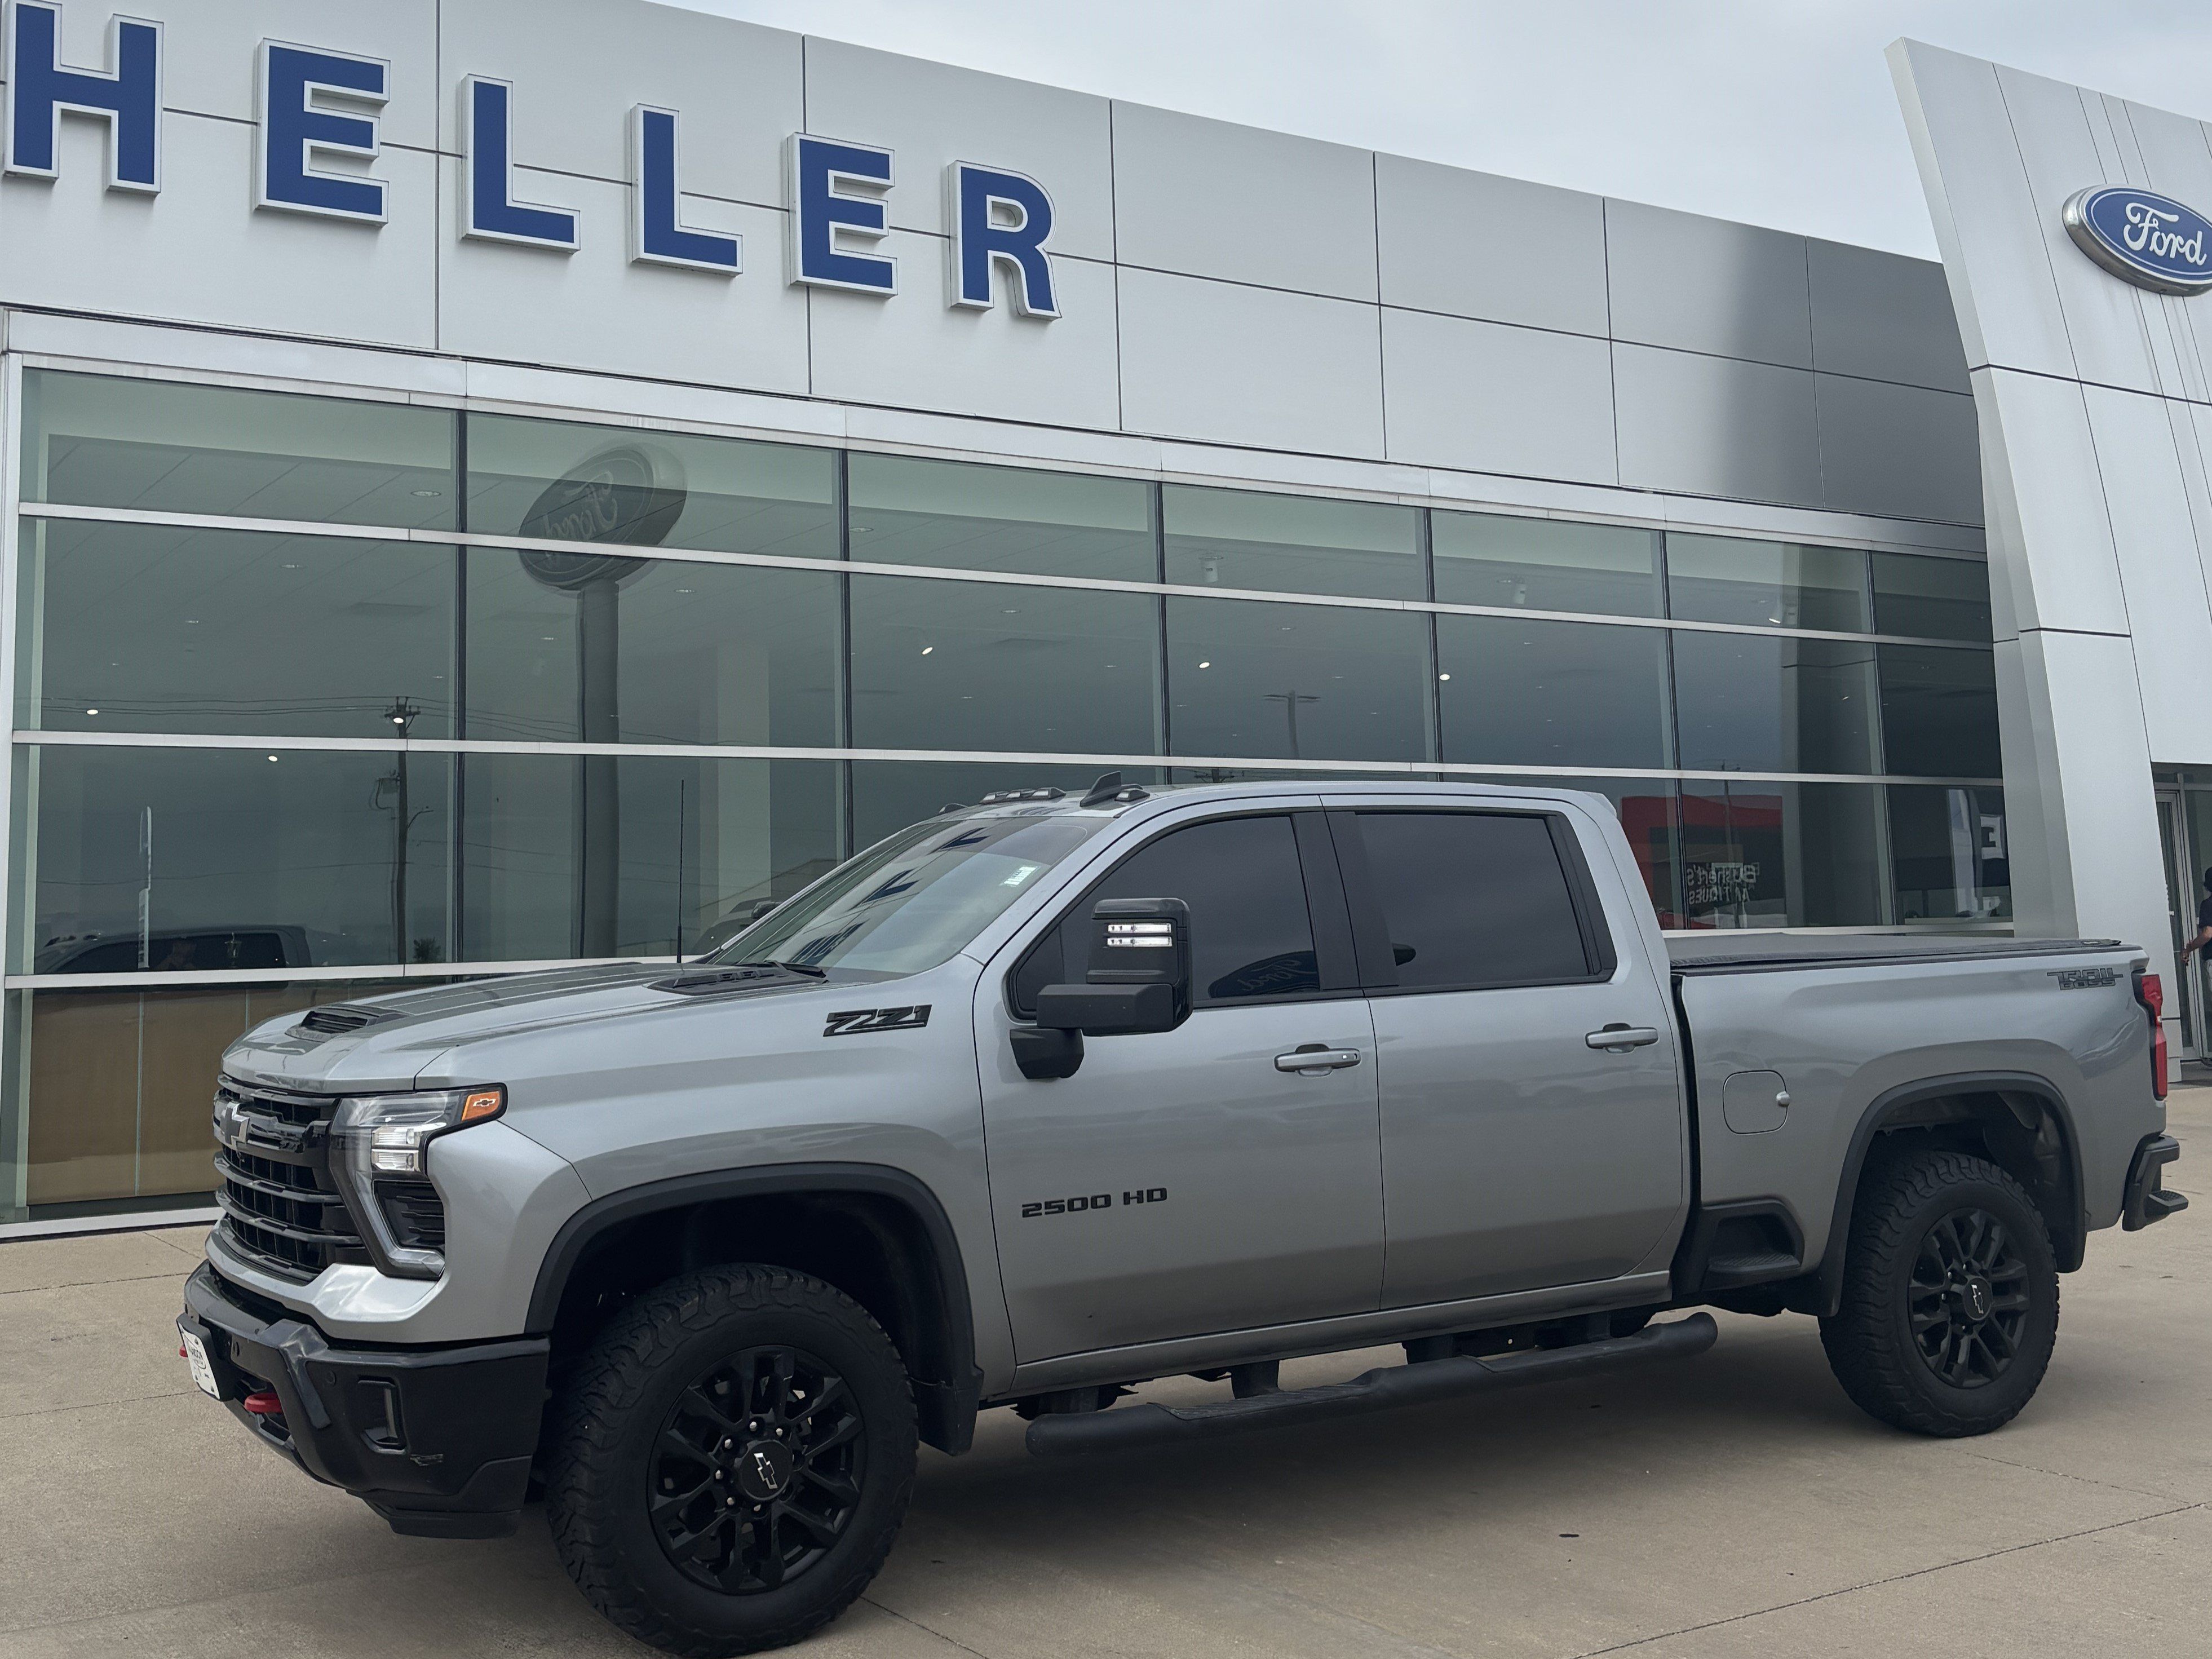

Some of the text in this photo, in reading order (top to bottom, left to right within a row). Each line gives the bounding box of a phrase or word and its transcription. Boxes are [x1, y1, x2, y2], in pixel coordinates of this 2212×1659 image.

[6, 1, 1060, 319] HELLER
[2123, 202, 2207, 266] Ford
[2047, 967, 2123, 982] TRAIL
[2059, 979, 2116, 990] BOSS
[1021, 1187, 1167, 1218] 2500 HD
